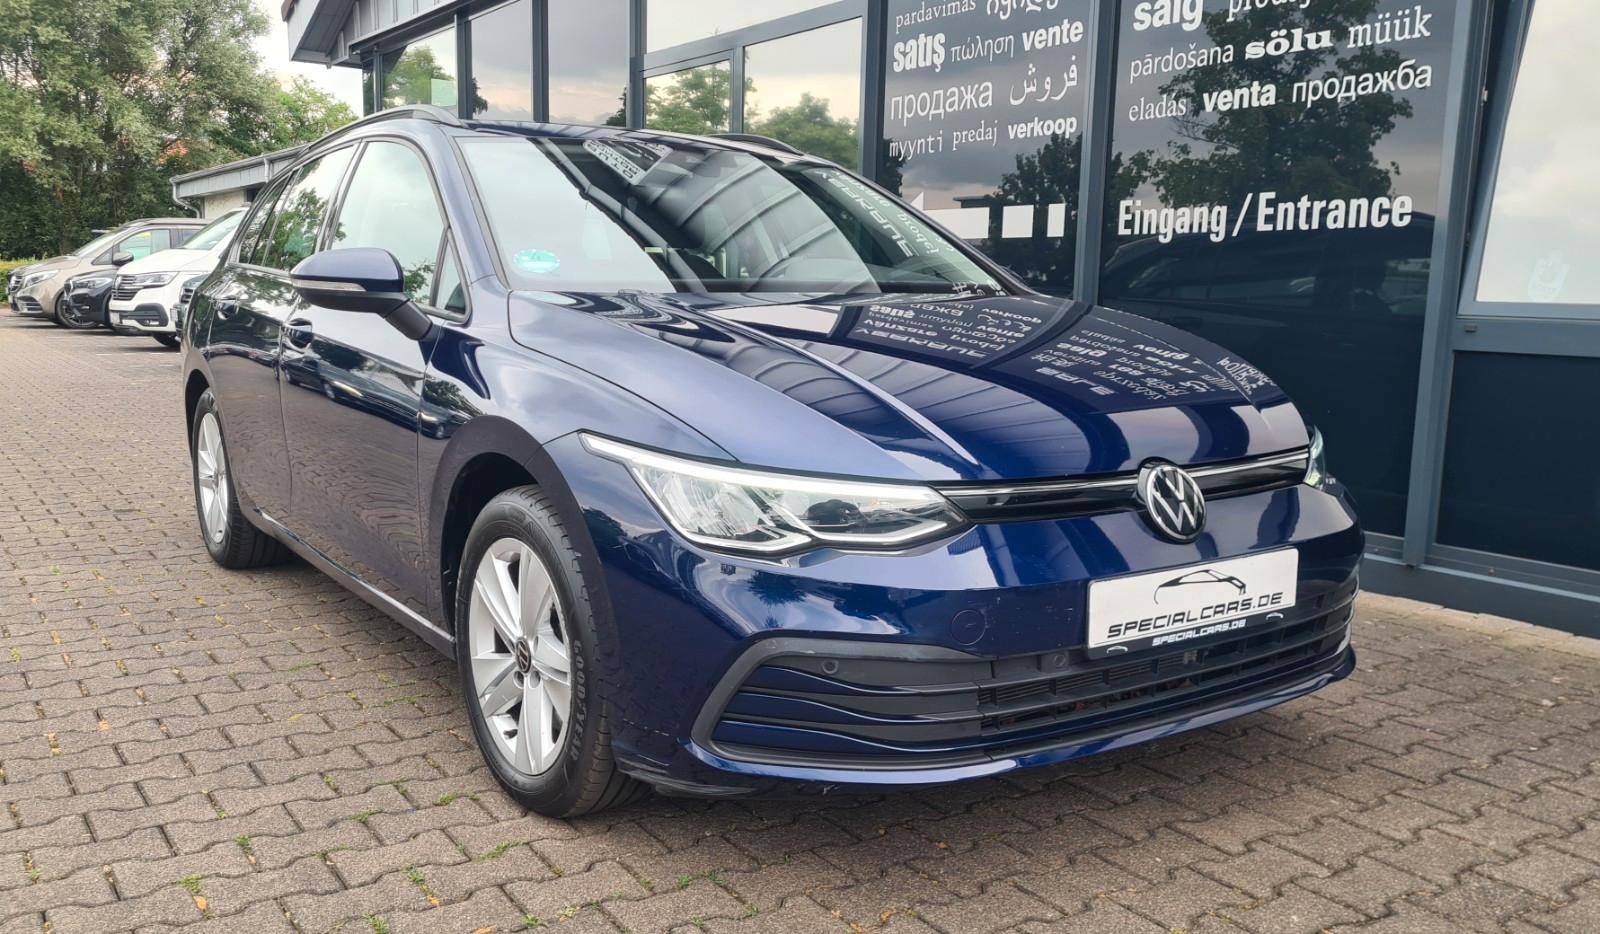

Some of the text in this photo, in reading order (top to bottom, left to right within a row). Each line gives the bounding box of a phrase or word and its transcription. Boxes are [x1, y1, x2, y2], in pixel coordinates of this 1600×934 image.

[896, 0, 976, 34] pardavimas
[1022, 19, 1084, 51] vente
[893, 33, 946, 72] satış
[951, 34, 1014, 62] πώληση
[1129, 42, 1234, 84] pārdošana
[1245, 27, 1334, 60] sölu
[1347, 6, 1433, 49] müük
[1010, 54, 1078, 105] فروش
[1129, 80, 1276, 122] eladás venta
[1292, 58, 1433, 108] продажба
[891, 81, 993, 127] продажа
[889, 116, 1077, 161] myynti predaj verkoop
[1117, 199, 1228, 244] Eingang
[1256, 192, 1413, 233] Entrance
[1107, 591, 1283, 639] SPECIALCARS.DE
[1152, 619, 1247, 647] SPECIALCARS.DE
